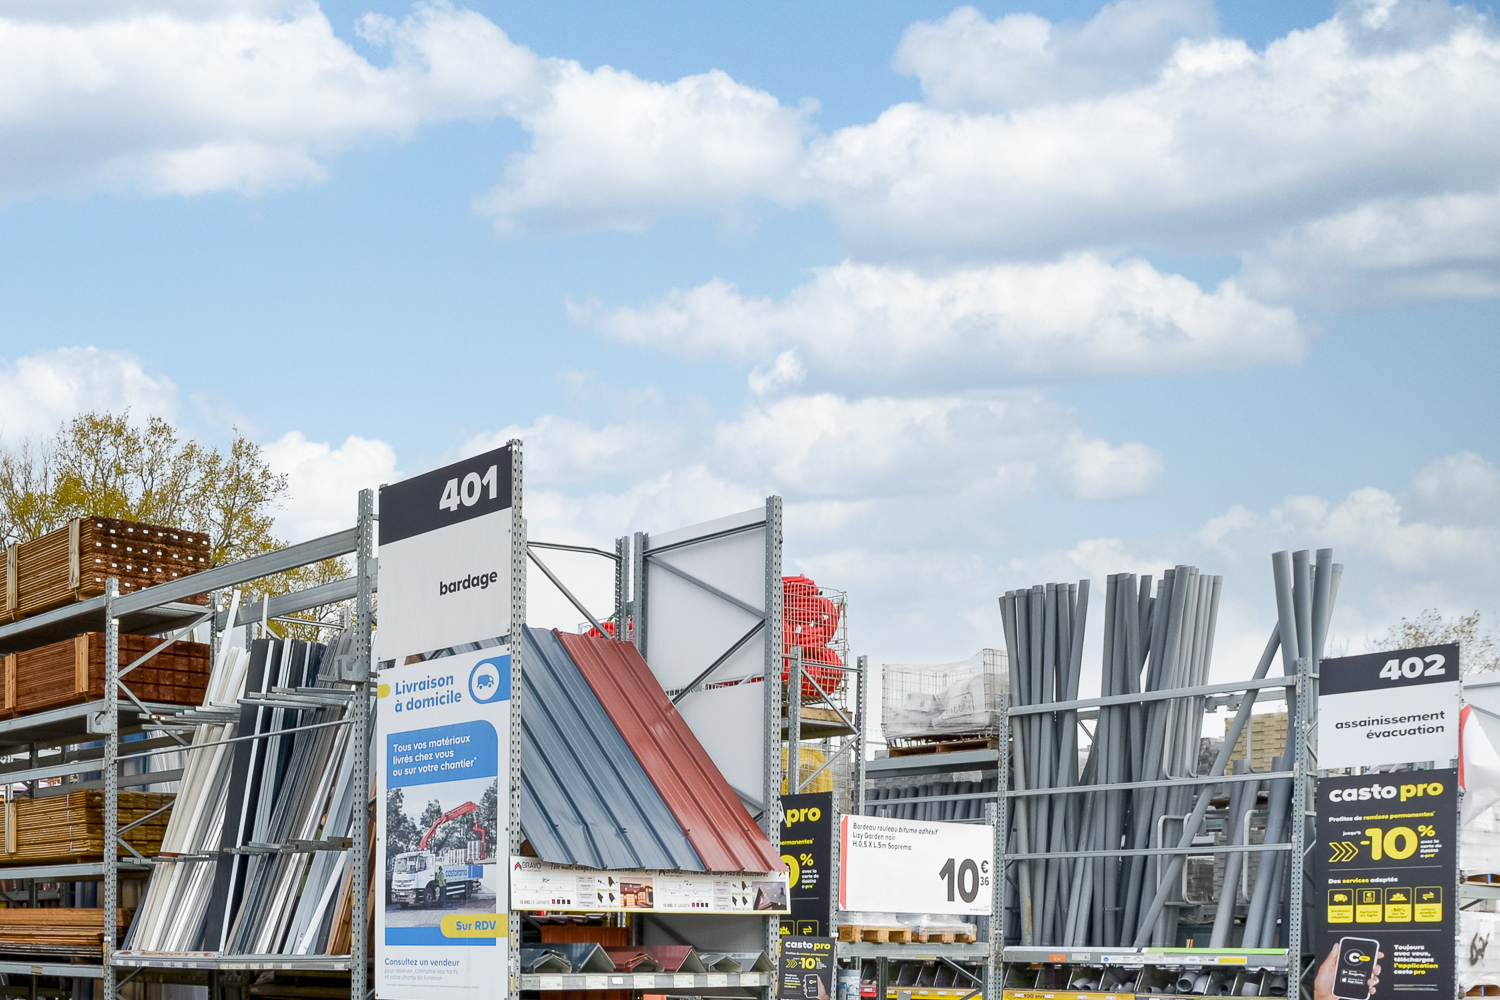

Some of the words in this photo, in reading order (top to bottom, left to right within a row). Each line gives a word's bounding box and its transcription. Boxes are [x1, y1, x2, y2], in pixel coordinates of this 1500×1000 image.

[439, 464, 498, 512] 401
[439, 571, 498, 596] bardage
[1379, 654, 1446, 680] 402
[395, 675, 454, 695] Livraison
[394, 701, 403, 713] à
[406, 690, 462, 711] domicile
[1335, 710, 1445, 730] assainissement
[1366, 724, 1445, 739] évacuation
[393, 743, 412, 753] Tous
[413, 741, 427, 750] vos
[428, 735, 471, 749] matériaux
[393, 754, 414, 765] livrés
[415, 752, 433, 763] chez
[435, 749, 455, 760] vous
[393, 768, 403, 777] ou
[404, 767, 417, 776] sur
[418, 763, 439, 774] votre
[1329, 784, 1398, 802] casto
[1400, 782, 1444, 802] pro
[786, 807, 821, 828] pro
[853, 831, 863, 839] Lizy
[918, 827, 939, 835] adhésif
[888, 843, 912, 851] Soprema
[939, 858, 980, 903] 10
[981, 860, 989, 873] €
[980, 876, 989, 886] 36
[456, 921, 472, 930] Sur
[475, 921, 497, 930] RDV
[785, 941, 813, 949] casto
[814, 943, 831, 951] pro
[384, 958, 418, 966] Consultez
[430, 958, 460, 967] vendeur
